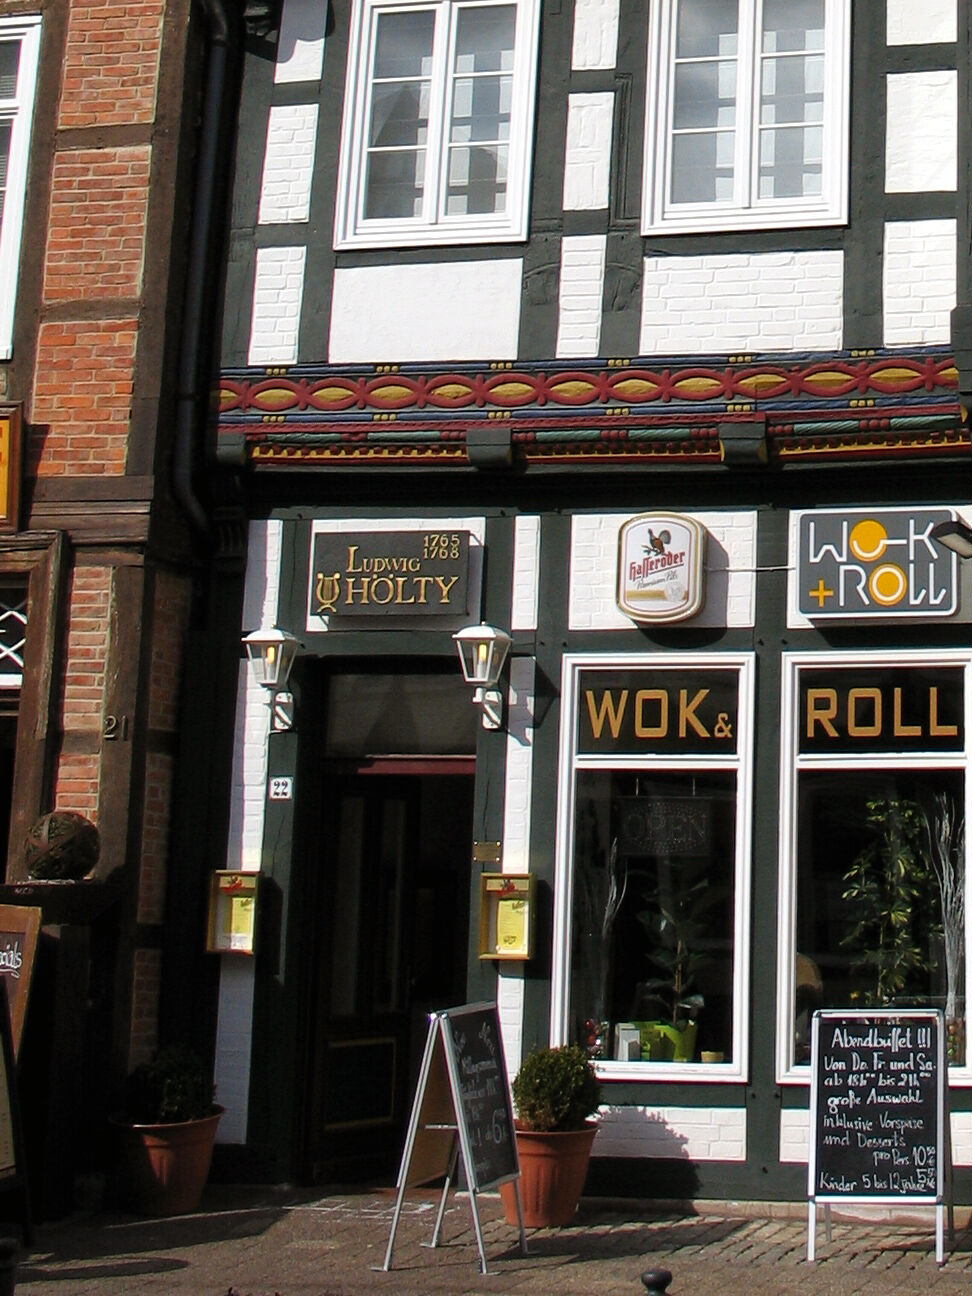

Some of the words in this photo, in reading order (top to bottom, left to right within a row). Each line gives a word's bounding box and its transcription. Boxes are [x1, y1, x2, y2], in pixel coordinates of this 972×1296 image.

[423, 534, 460, 547] 1765
[346, 546, 421, 572] LUDWIG
[423, 547, 460, 559] 1768
[345, 573, 459, 604] HÖLTY
[839, 563, 947, 607] ROLL
[806, 687, 958, 738] ROLL
[103, 715, 128, 741] 21
[273, 780, 288, 797] 22
[890, 1052, 914, 1071] und
[824, 1073, 843, 1086] ab
[878, 1072, 896, 1086] bis
[867, 1088, 923, 1104] Auswahl
[823, 1130, 850, 1145] und
[857, 1130, 906, 1148] Desserts
[873, 1150, 890, 1166] pro
[820, 1172, 857, 1191] Kinder
[862, 1174, 871, 1189] 5
